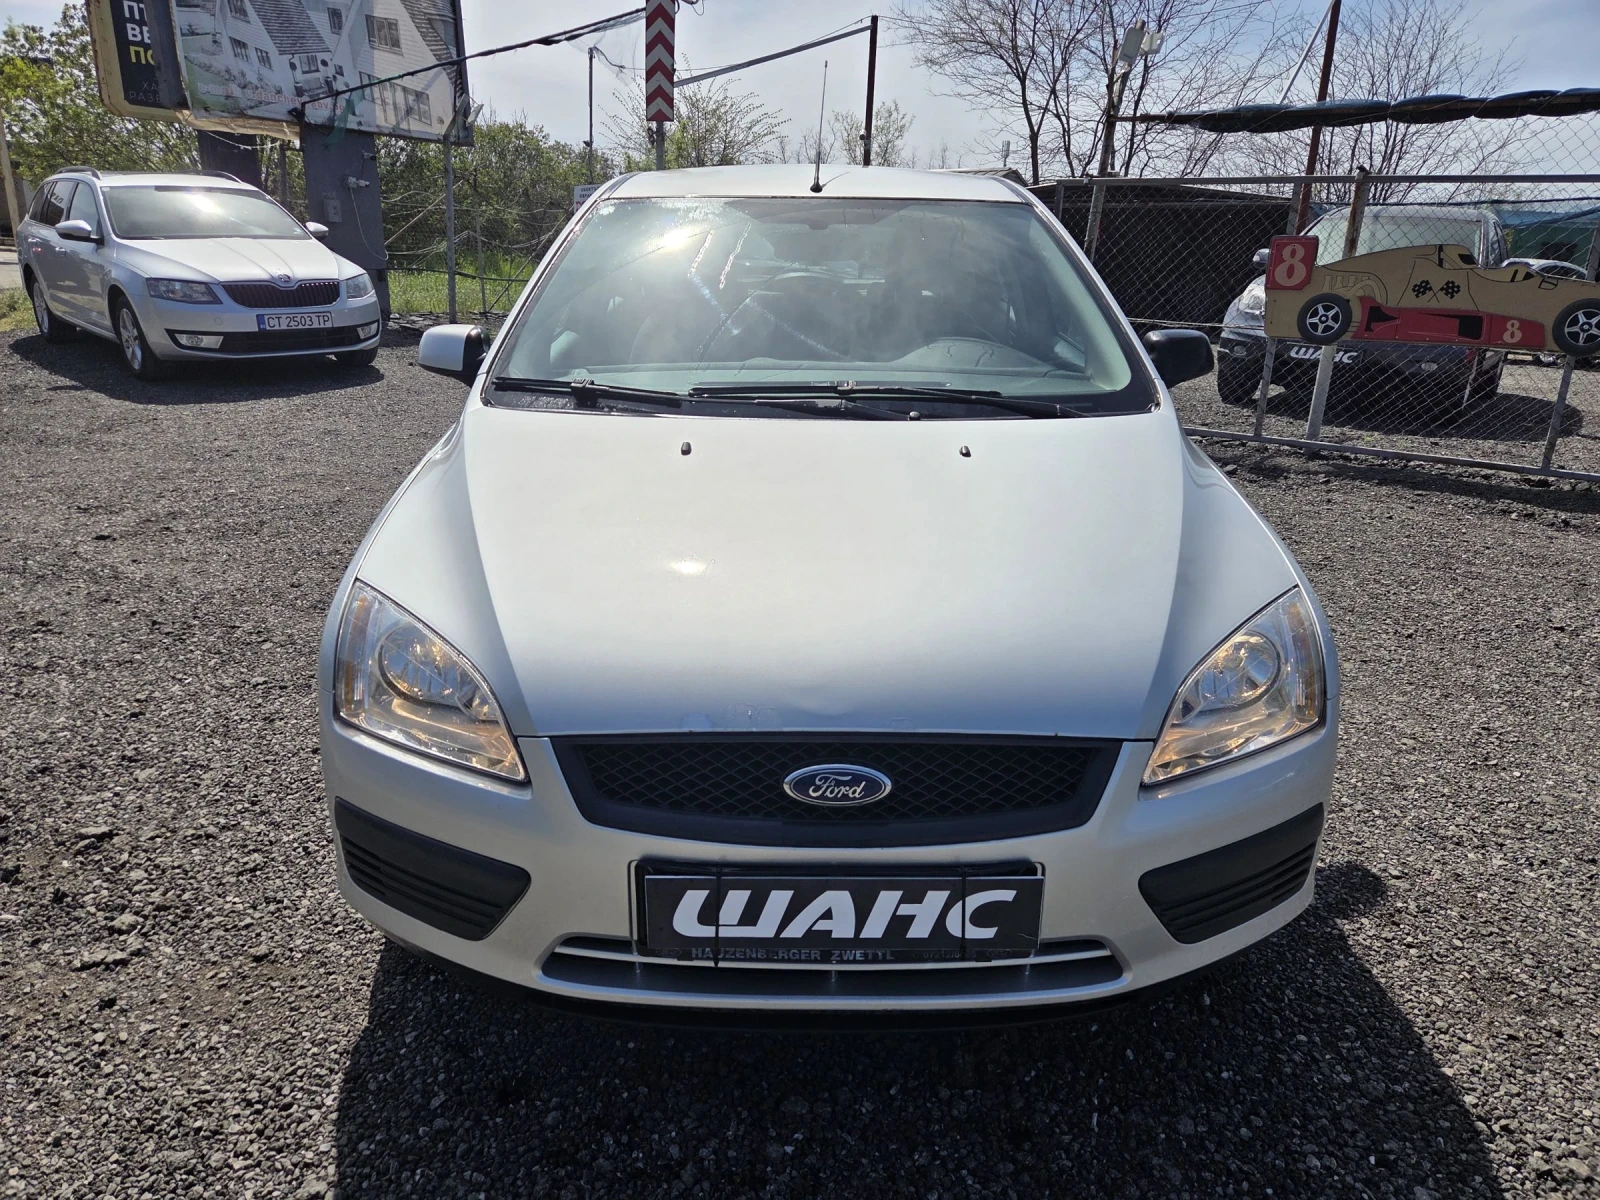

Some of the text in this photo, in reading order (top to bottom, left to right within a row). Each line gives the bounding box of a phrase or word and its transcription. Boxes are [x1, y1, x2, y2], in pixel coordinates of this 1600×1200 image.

[1274, 243, 1307, 287] 8
[285, 315, 314, 328] 2503
[1502, 320, 1523, 344] 8
[809, 774, 865, 799] Ford
[672, 889, 1018, 939] ШАНС
[830, 948, 895, 961] ZWETTL
